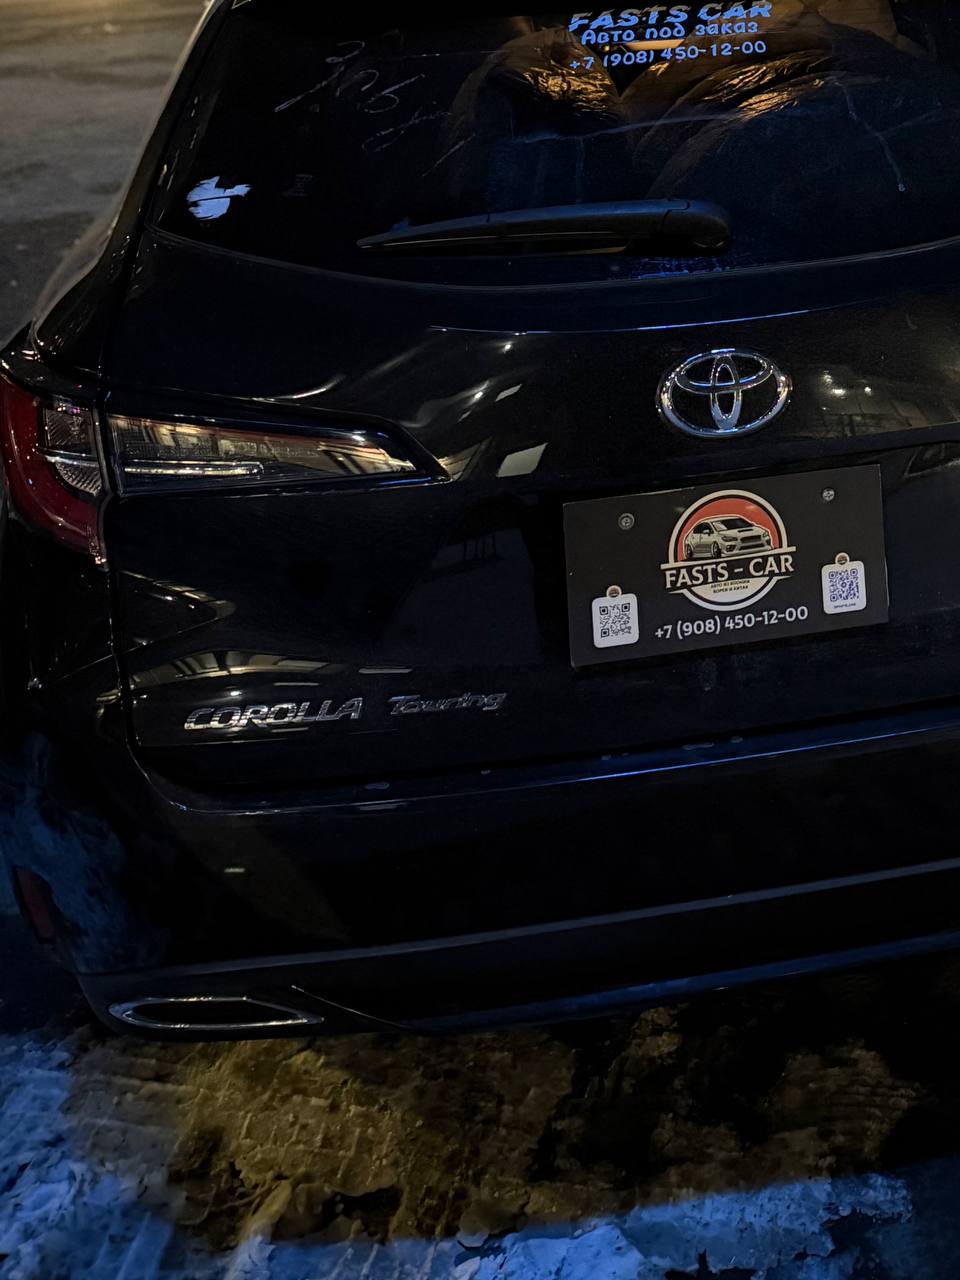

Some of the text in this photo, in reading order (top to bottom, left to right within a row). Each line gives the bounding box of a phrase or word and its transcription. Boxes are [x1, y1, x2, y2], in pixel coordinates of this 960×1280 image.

[568, 0, 773, 32] FASTS CAR
[581, 21, 758, 46] Авто под заказ
[569, 40, 766, 70] +7 (908) 450-12-00
[665, 563, 729, 589] FASTS
[749, 554, 795, 577] CAR
[655, 606, 808, 640] +7 (908) 450-12-00
[184, 692, 507, 730] COROLLA Touring
